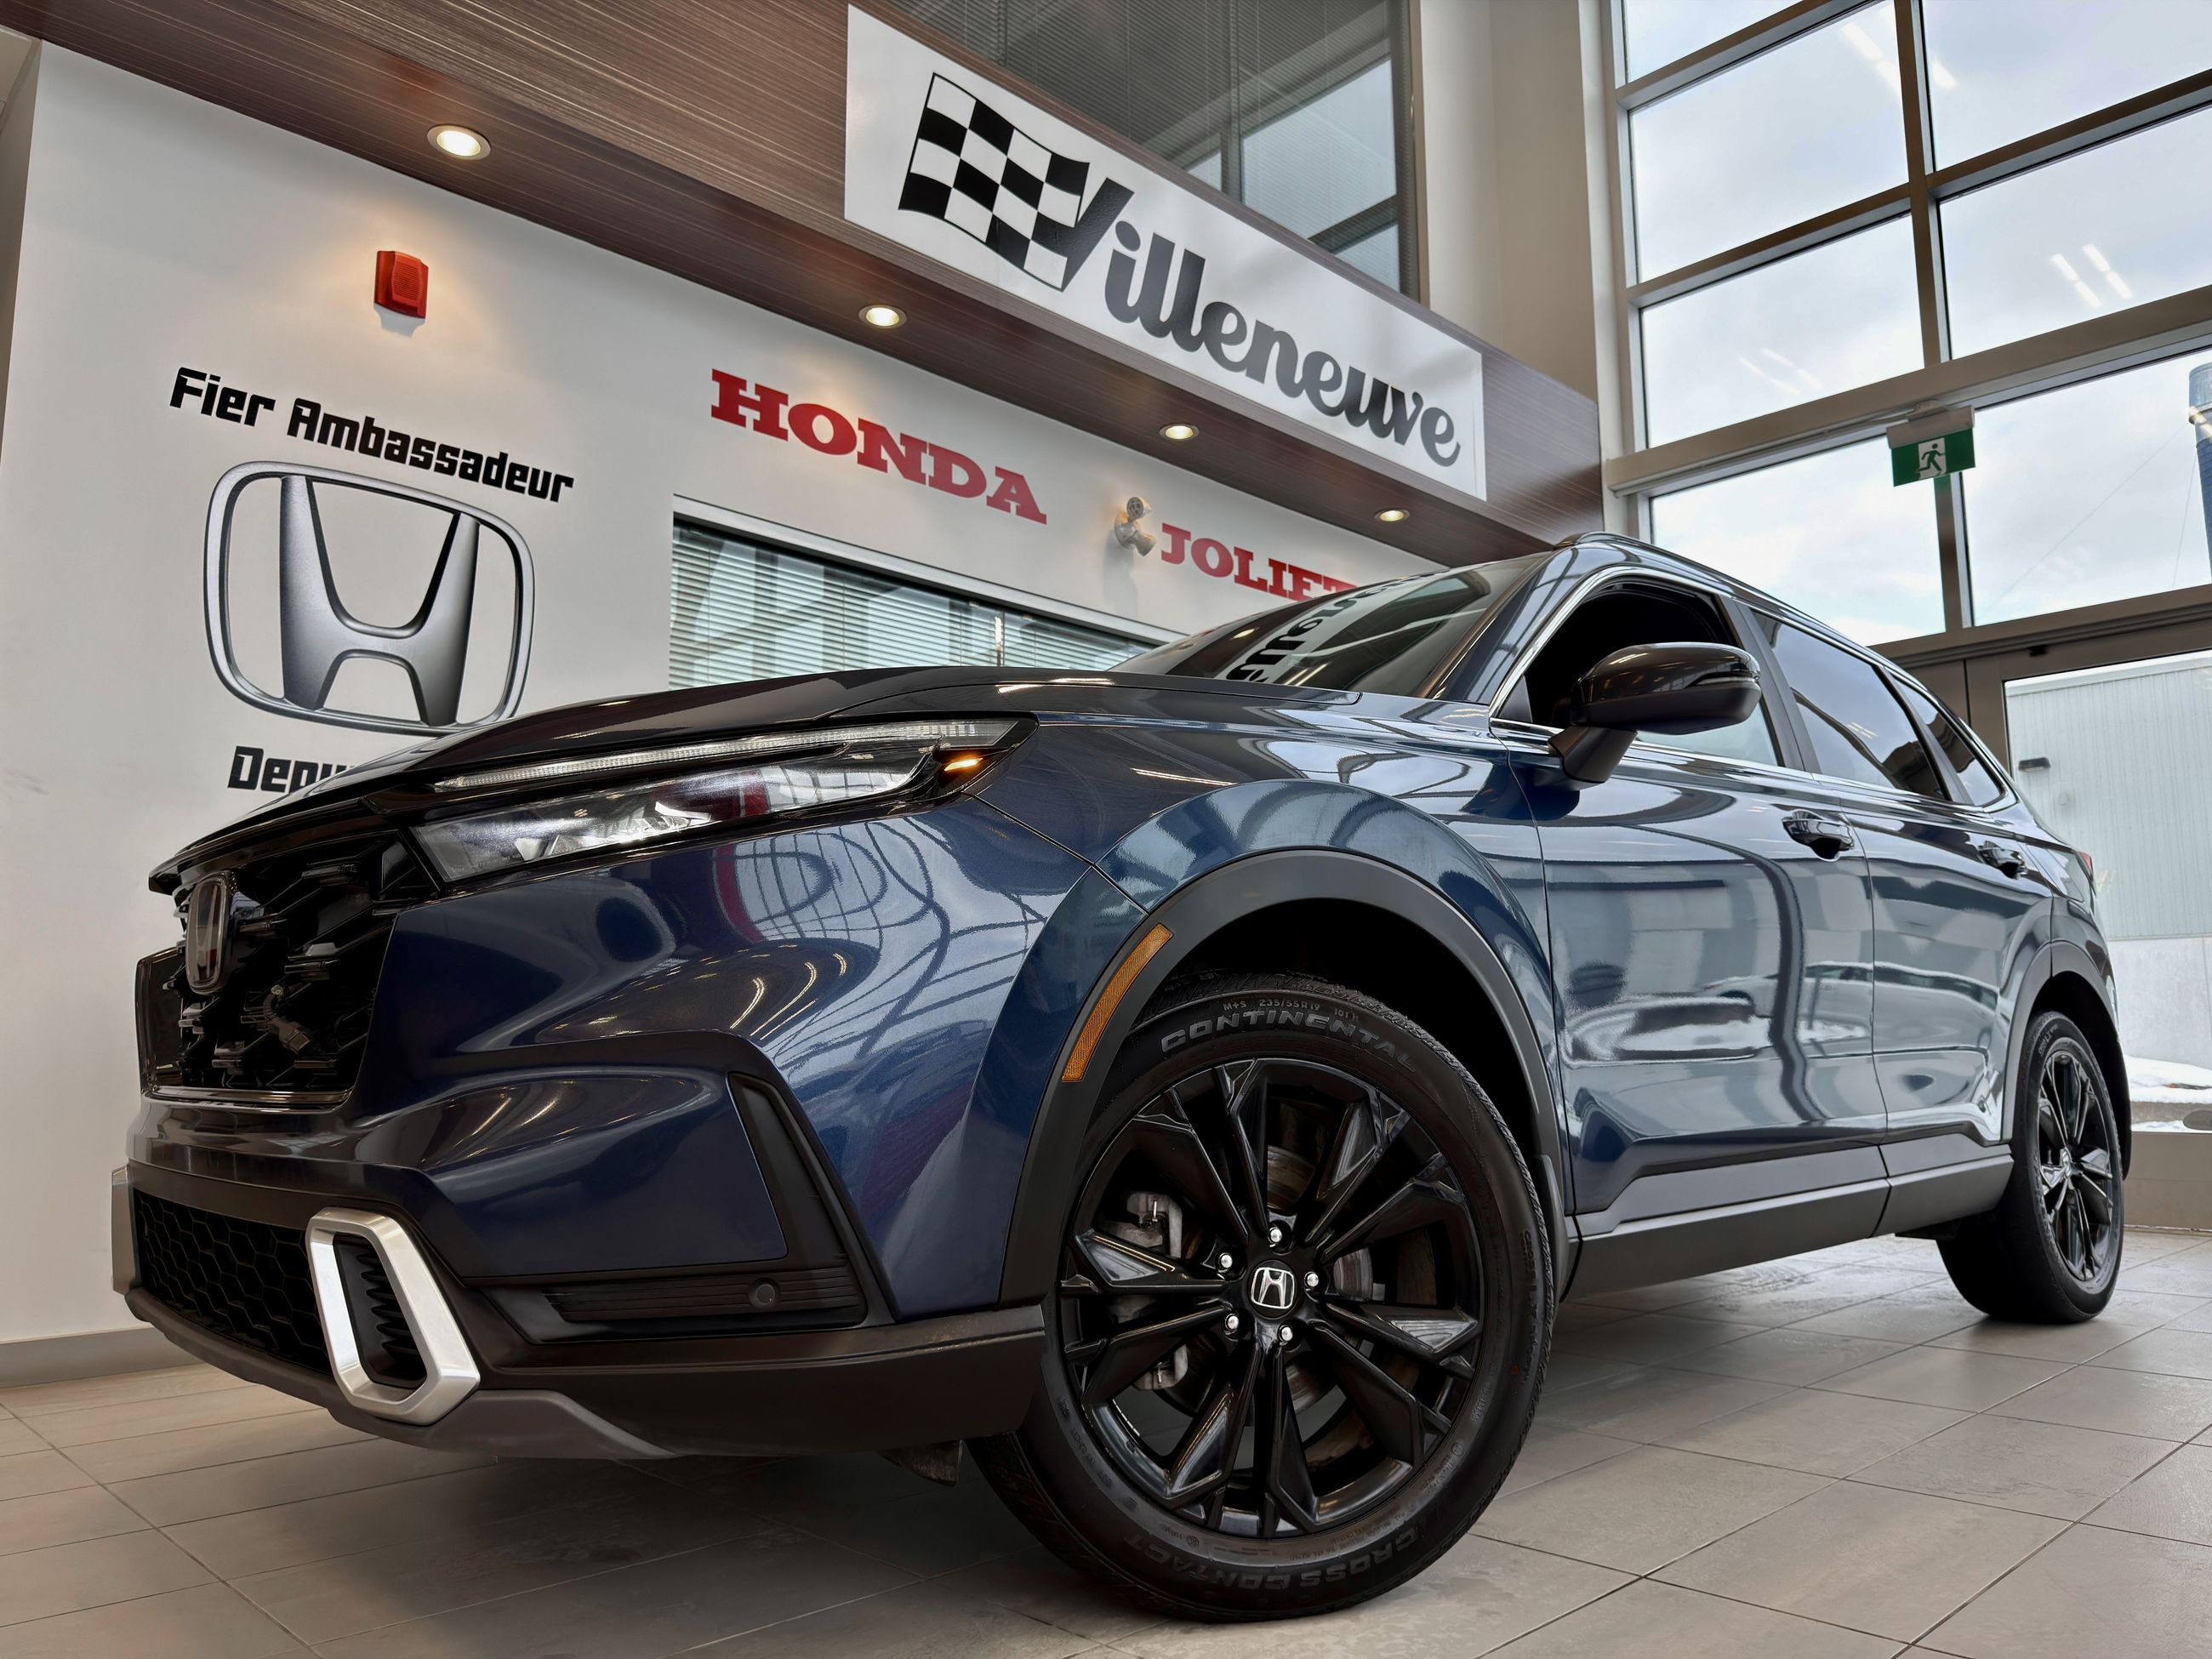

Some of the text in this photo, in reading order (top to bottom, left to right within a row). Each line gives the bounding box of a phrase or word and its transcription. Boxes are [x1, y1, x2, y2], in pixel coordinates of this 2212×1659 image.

[1021, 175, 1462, 468] Villeneuve
[169, 367, 574, 503] Fier Ambassadeur
[711, 369, 1046, 524] HONDA
[1161, 1009, 1416, 1073] CONTINENTAL
[1122, 1534, 1291, 1590] CONTACT
[1300, 1526, 1419, 1588] CROSS
